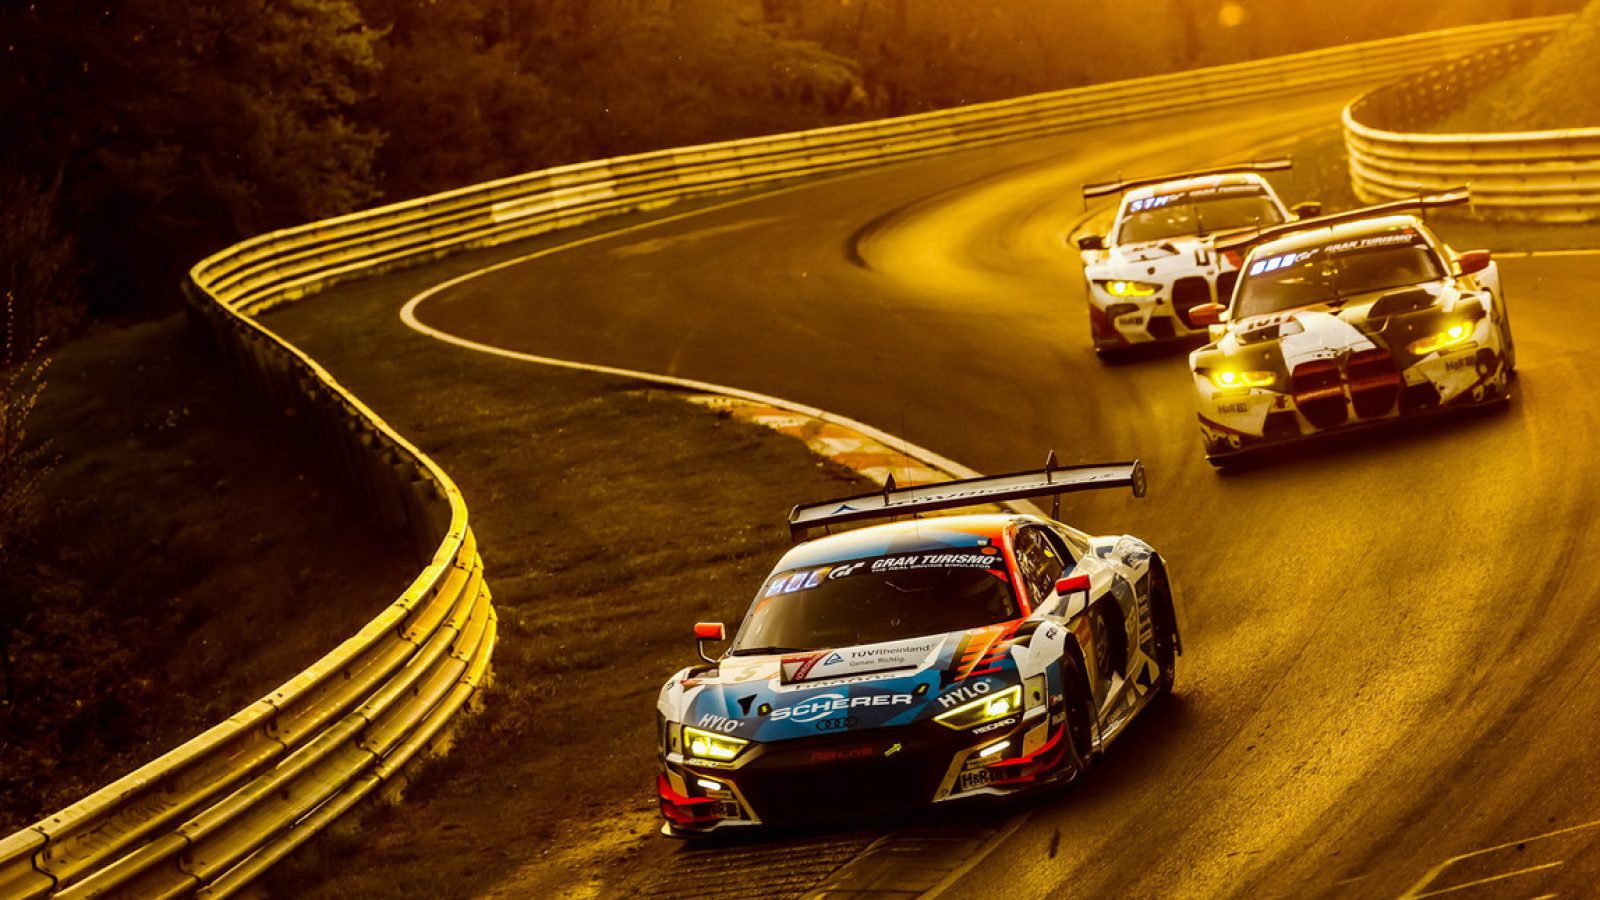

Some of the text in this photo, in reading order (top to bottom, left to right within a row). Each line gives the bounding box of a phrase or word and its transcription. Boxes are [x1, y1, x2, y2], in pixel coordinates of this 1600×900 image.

[1324, 234, 1413, 253] GRAN TURISMO
[871, 554, 995, 569] GRAN TURISMO
[938, 681, 990, 708] HYLO
[770, 694, 912, 721] SCHERER
[698, 713, 738, 733] HYLO
